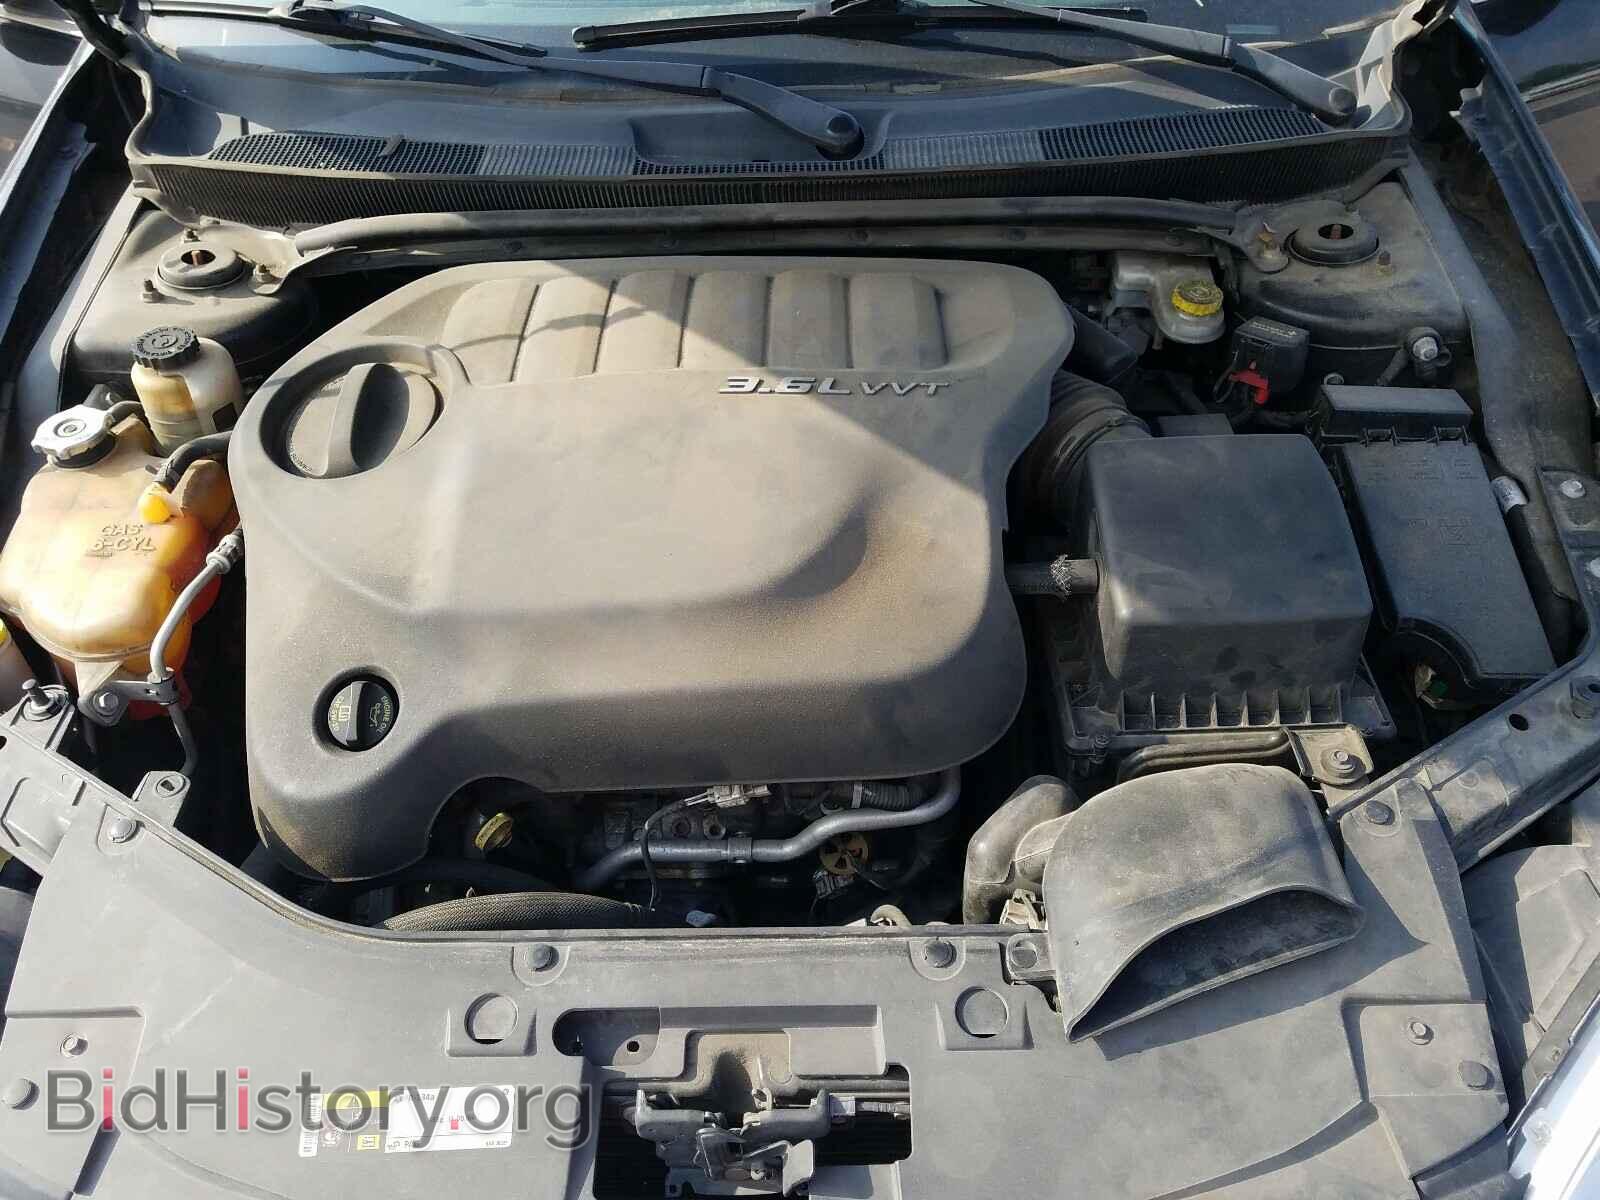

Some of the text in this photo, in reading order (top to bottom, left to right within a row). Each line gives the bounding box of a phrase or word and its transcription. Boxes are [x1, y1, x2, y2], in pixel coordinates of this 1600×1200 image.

[719, 376, 950, 397] 3.6L VVT
[375, 695, 392, 735] ENGINE OIL
